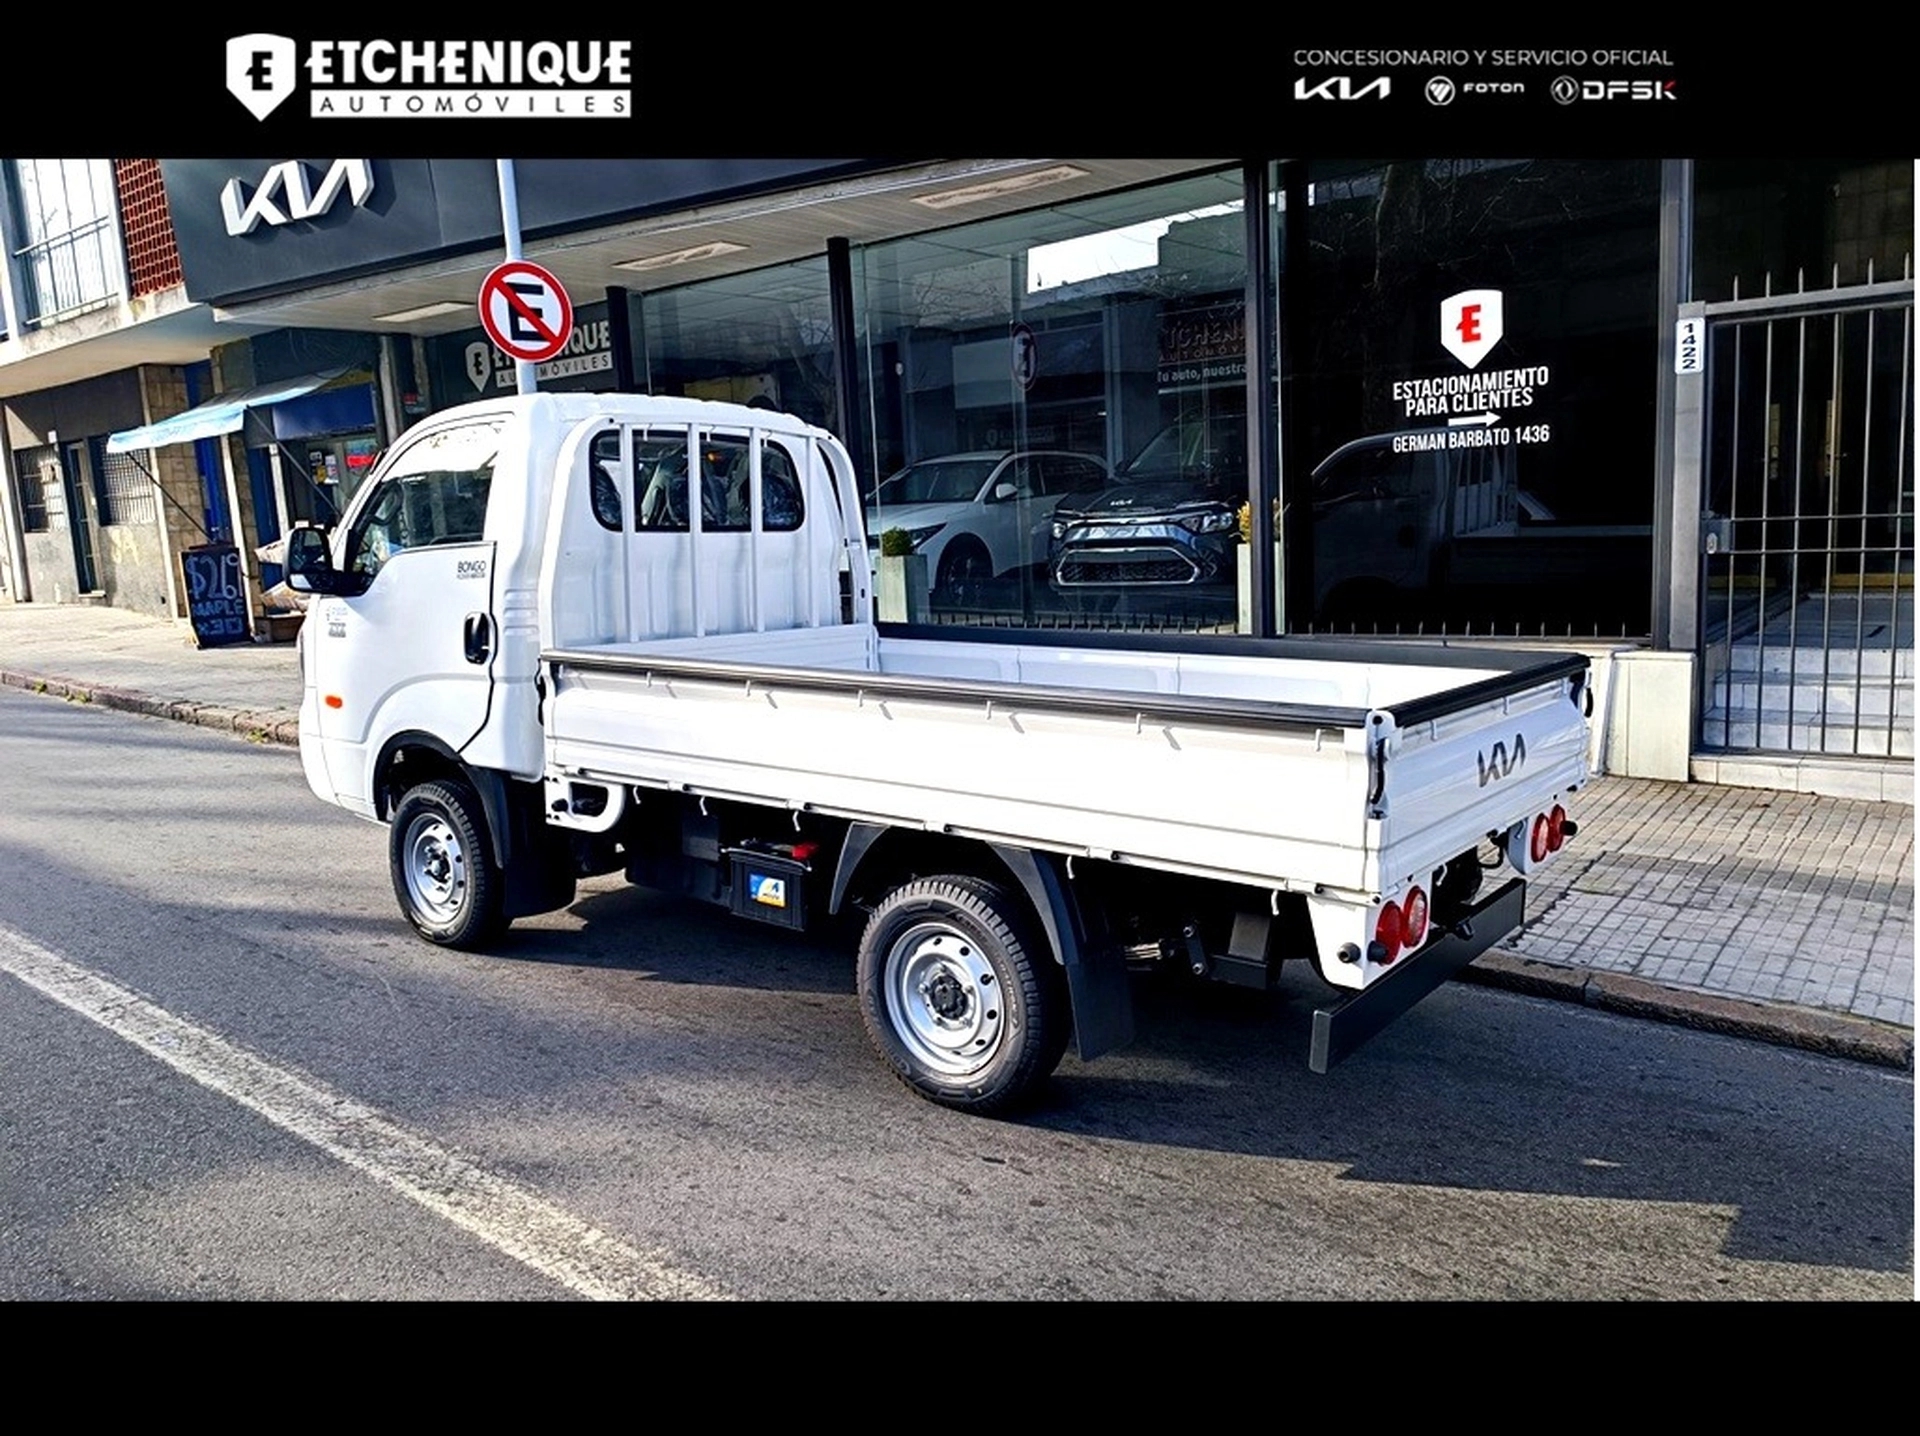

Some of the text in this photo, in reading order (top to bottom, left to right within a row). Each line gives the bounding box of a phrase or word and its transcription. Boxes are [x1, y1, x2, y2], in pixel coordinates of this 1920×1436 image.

[506, 282, 548, 343] E
[1682, 323, 1696, 370] 1422
[500, 354, 609, 383] AUMÓVILES
[1393, 366, 1549, 401] ESTACIONAMIENTO
[1405, 387, 1533, 417] PARA CLIENTES
[1392, 424, 1550, 453] GERMAN BARBATO 1436
[457, 560, 487, 573] BONGO
[1477, 732, 1526, 788] KIA
